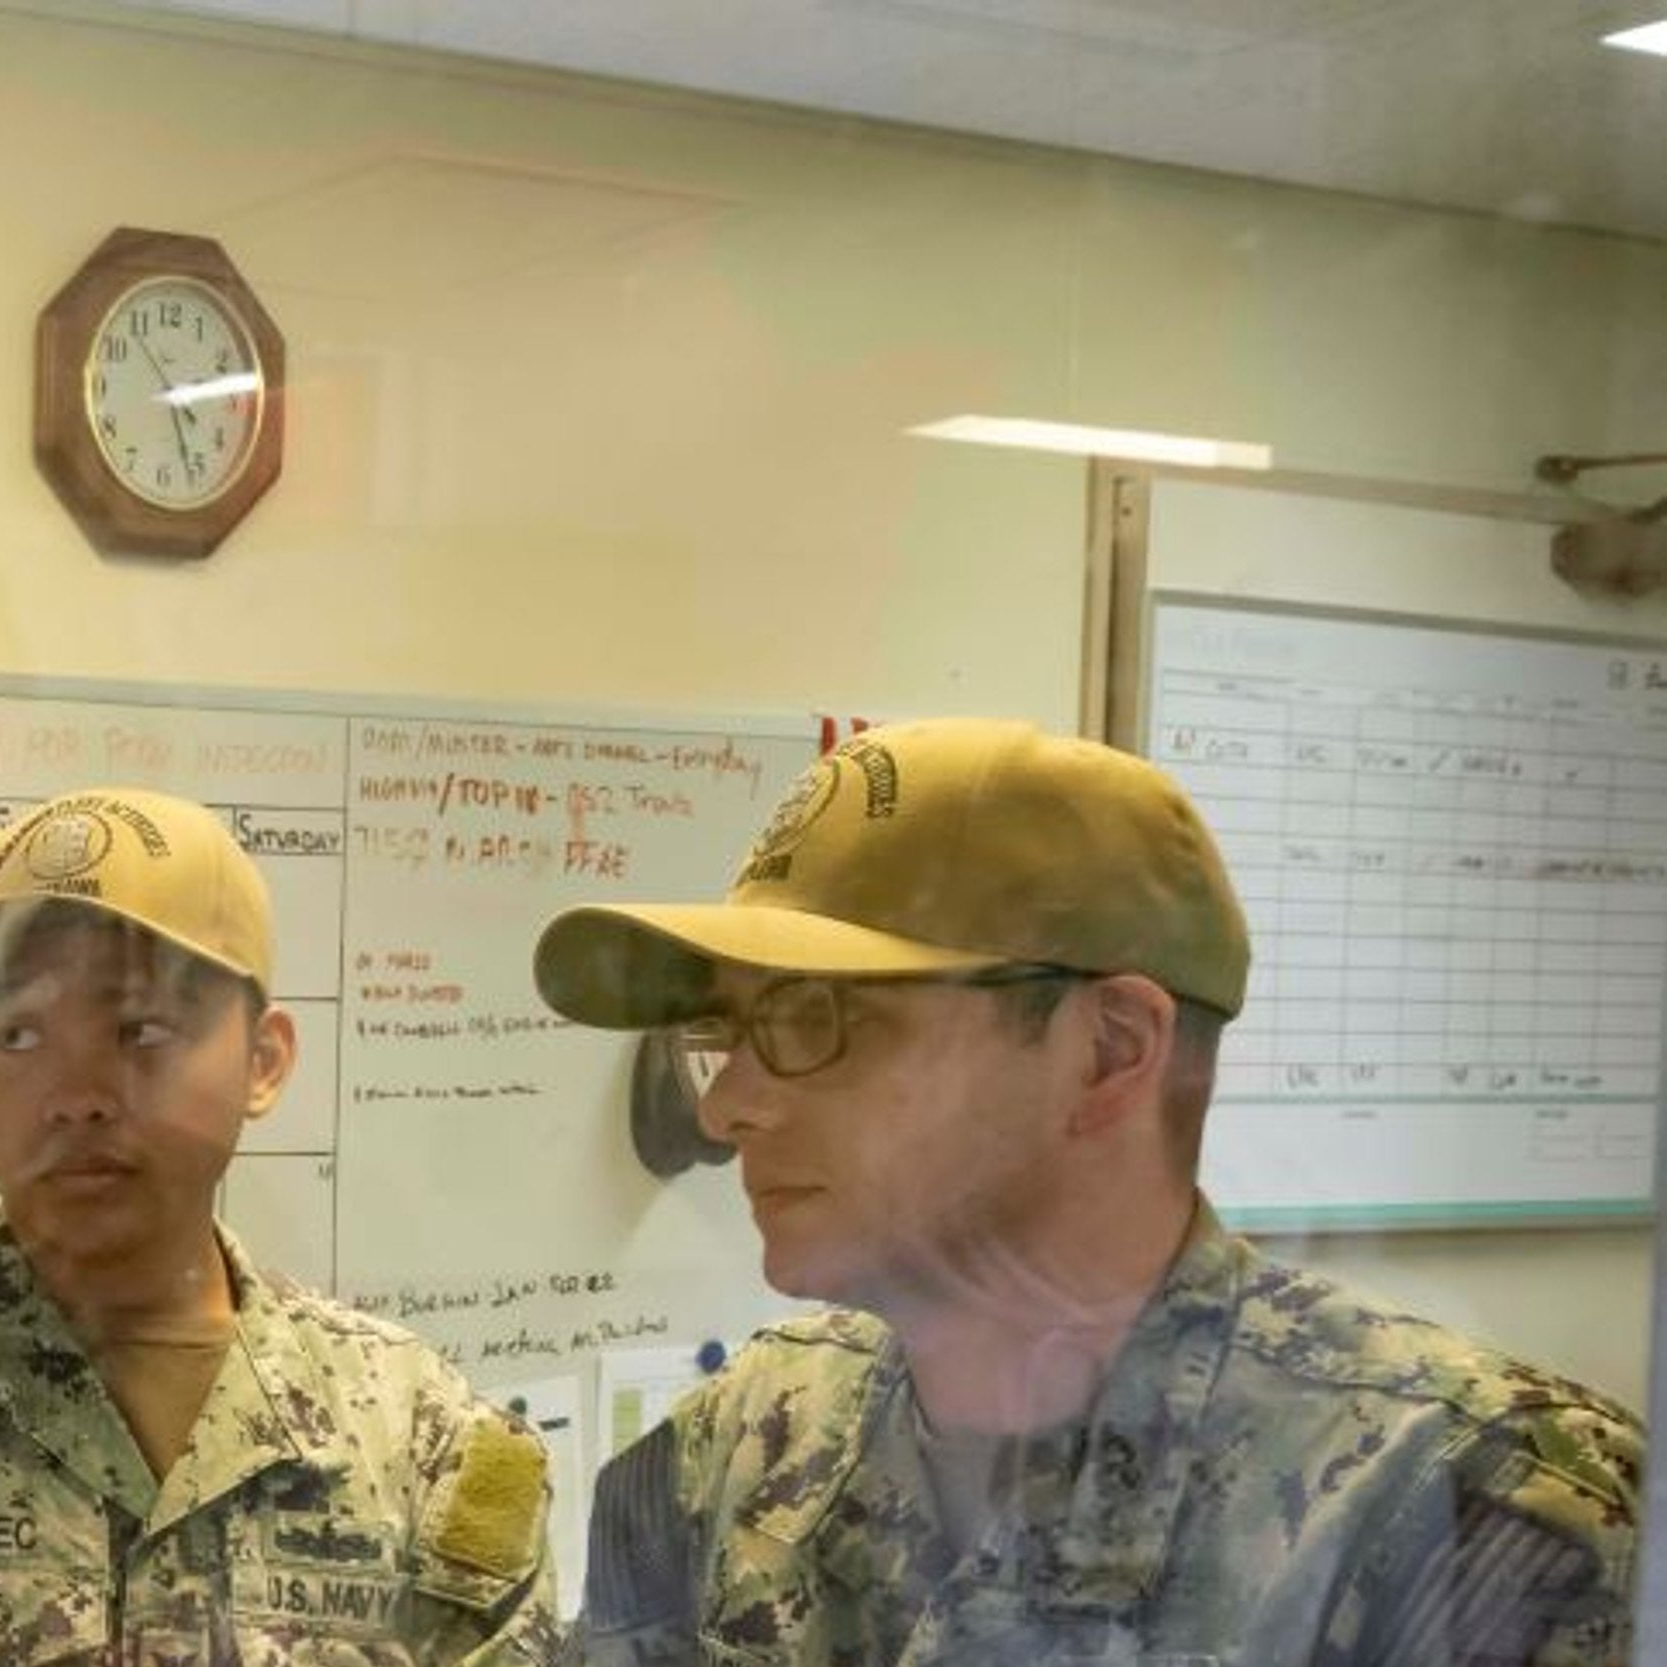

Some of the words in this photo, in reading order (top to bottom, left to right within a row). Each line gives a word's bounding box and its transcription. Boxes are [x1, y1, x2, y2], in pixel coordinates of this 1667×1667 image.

[130, 311, 149, 336] 11
[158, 303, 183, 328] 12
[194, 316, 203, 342] 1
[215, 351, 228, 374] 2
[239, 812, 341, 852] SATURDAY
[266, 1575, 314, 1616] U.S.
[322, 1579, 395, 1626] NAVY
